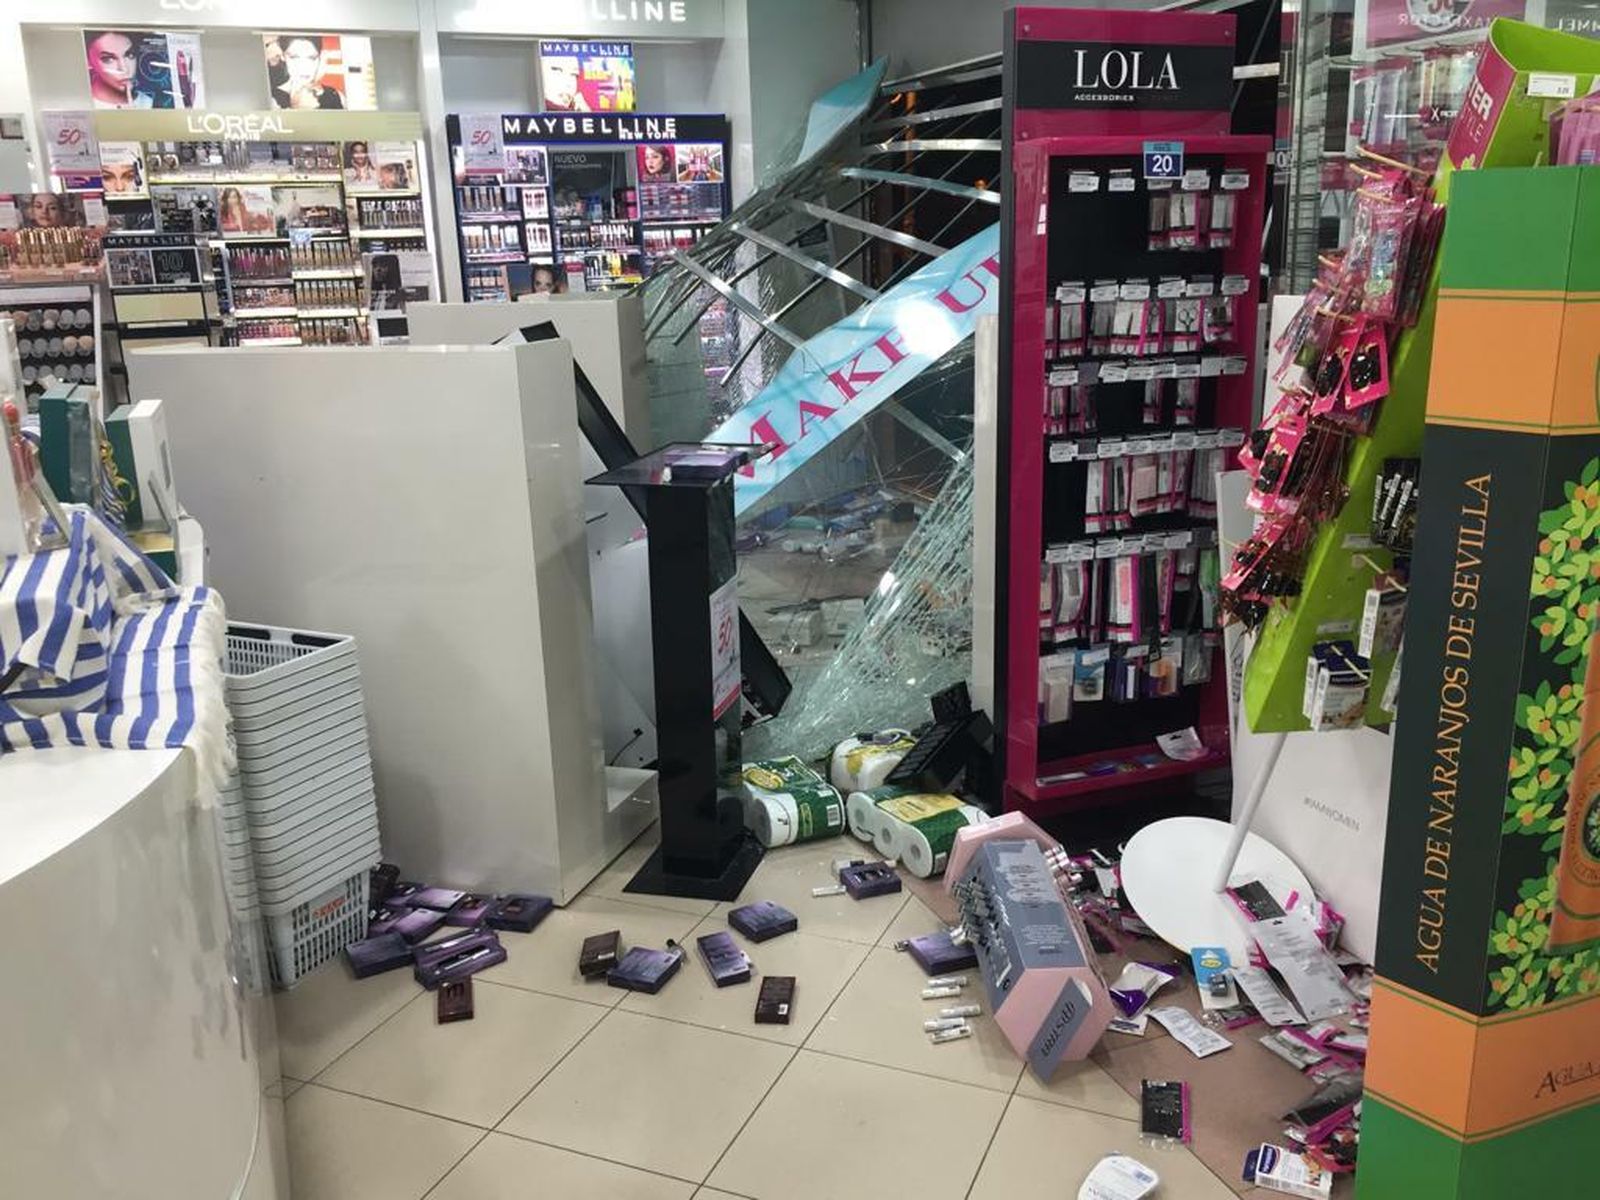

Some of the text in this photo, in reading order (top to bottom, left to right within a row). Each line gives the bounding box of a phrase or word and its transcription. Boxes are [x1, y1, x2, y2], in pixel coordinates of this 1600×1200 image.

[1072, 49, 1180, 90] LOLA
[1073, 93, 1135, 102] ACCESSORIES
[186, 112, 294, 134] L'ORÉAL
[503, 116, 676, 134] MAYBELLINE
[1152, 154, 1173, 173] 20
[1416, 473, 1492, 974] AGUA DE NARANJOS DE SEVILLA
